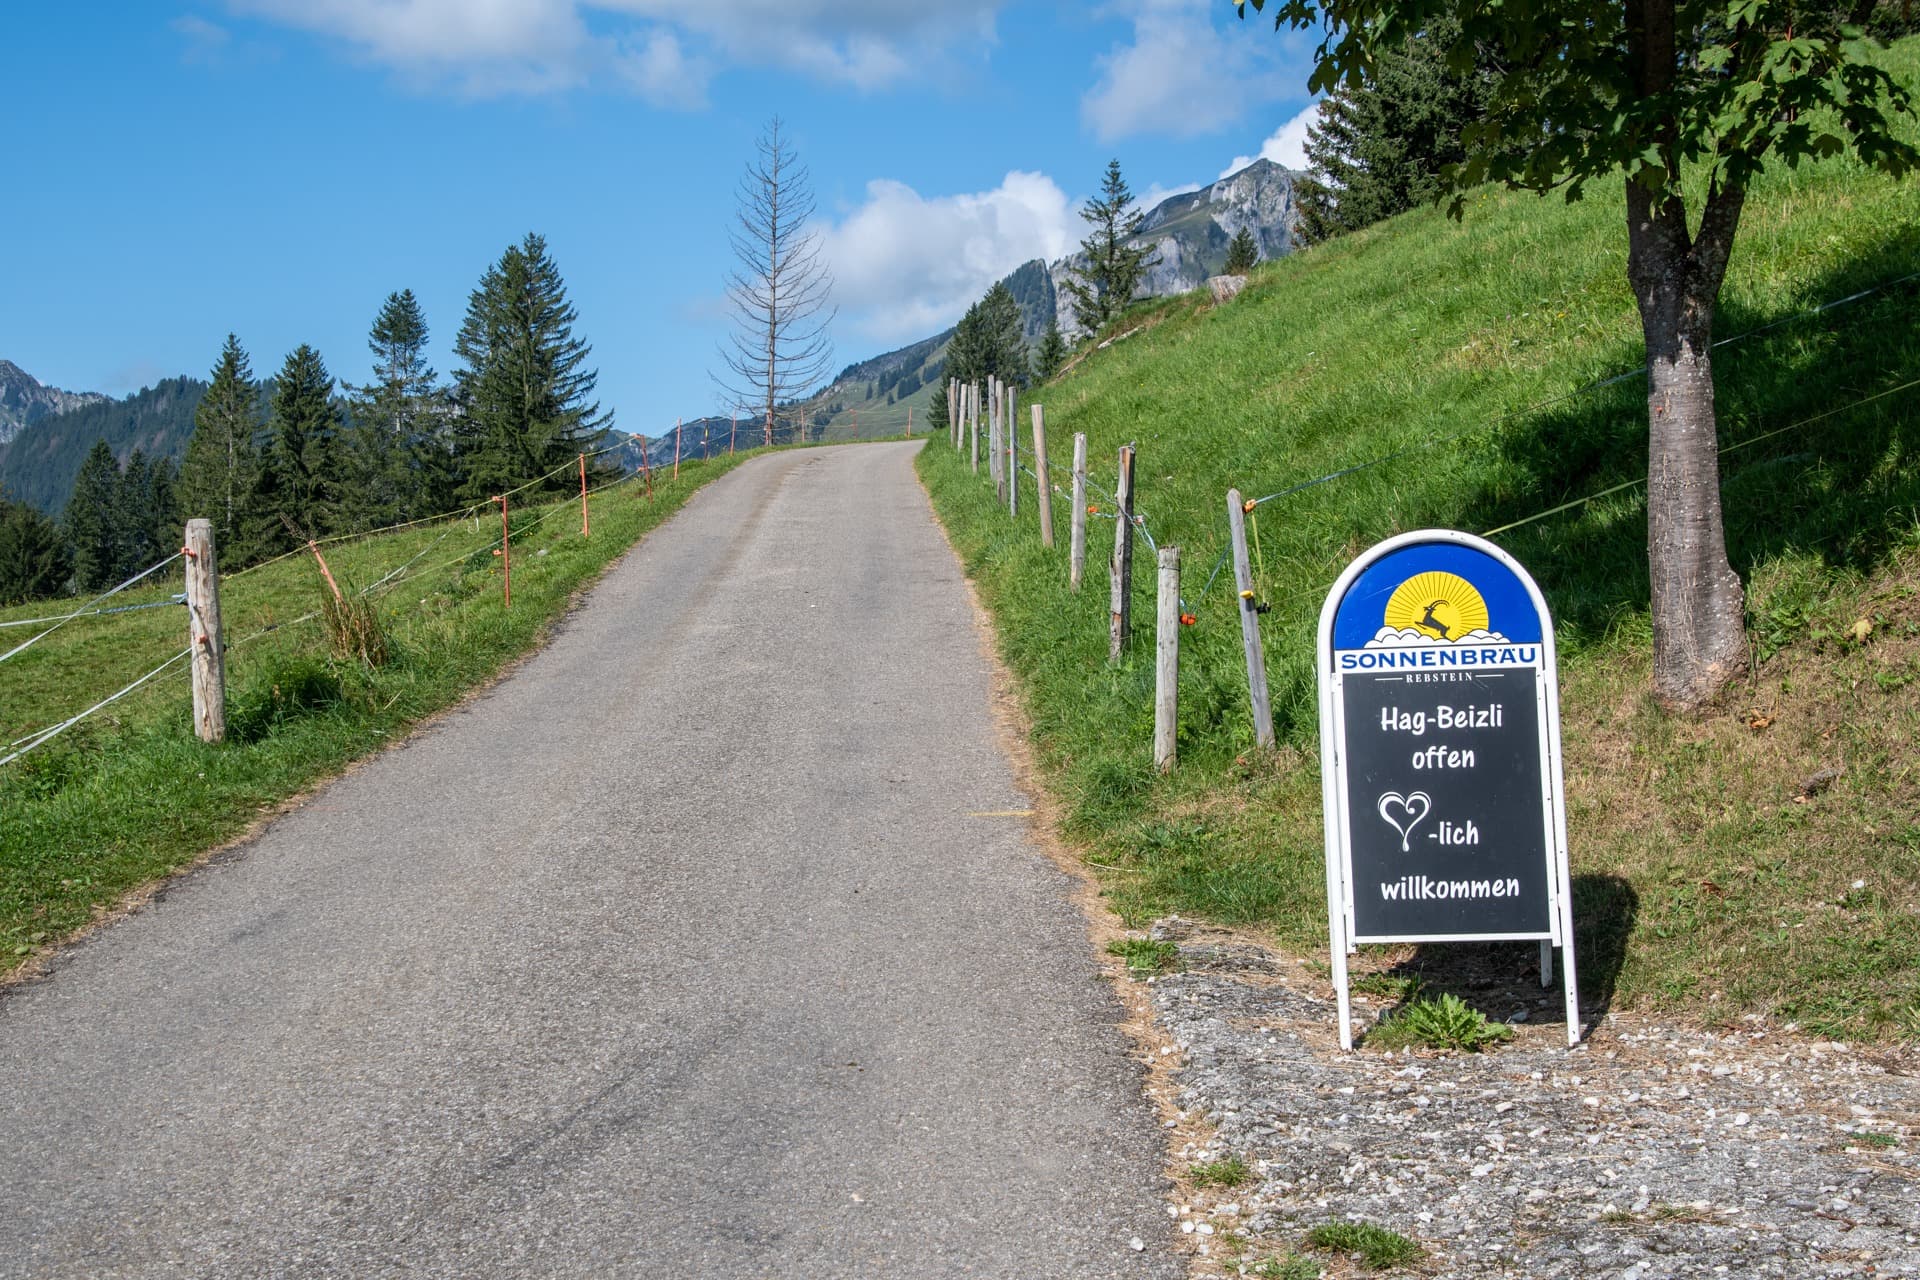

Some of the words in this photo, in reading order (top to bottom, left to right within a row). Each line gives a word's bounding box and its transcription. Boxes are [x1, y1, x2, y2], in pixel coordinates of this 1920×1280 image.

[1341, 647, 1536, 670] SONNENBRÄU
[1405, 671, 1473, 684] REBSTEIN
[1380, 703, 1503, 736] Hag-Beizli
[1411, 745, 1475, 770] offen
[1428, 819, 1479, 845] -lich
[1380, 875, 1520, 901] willkommen
